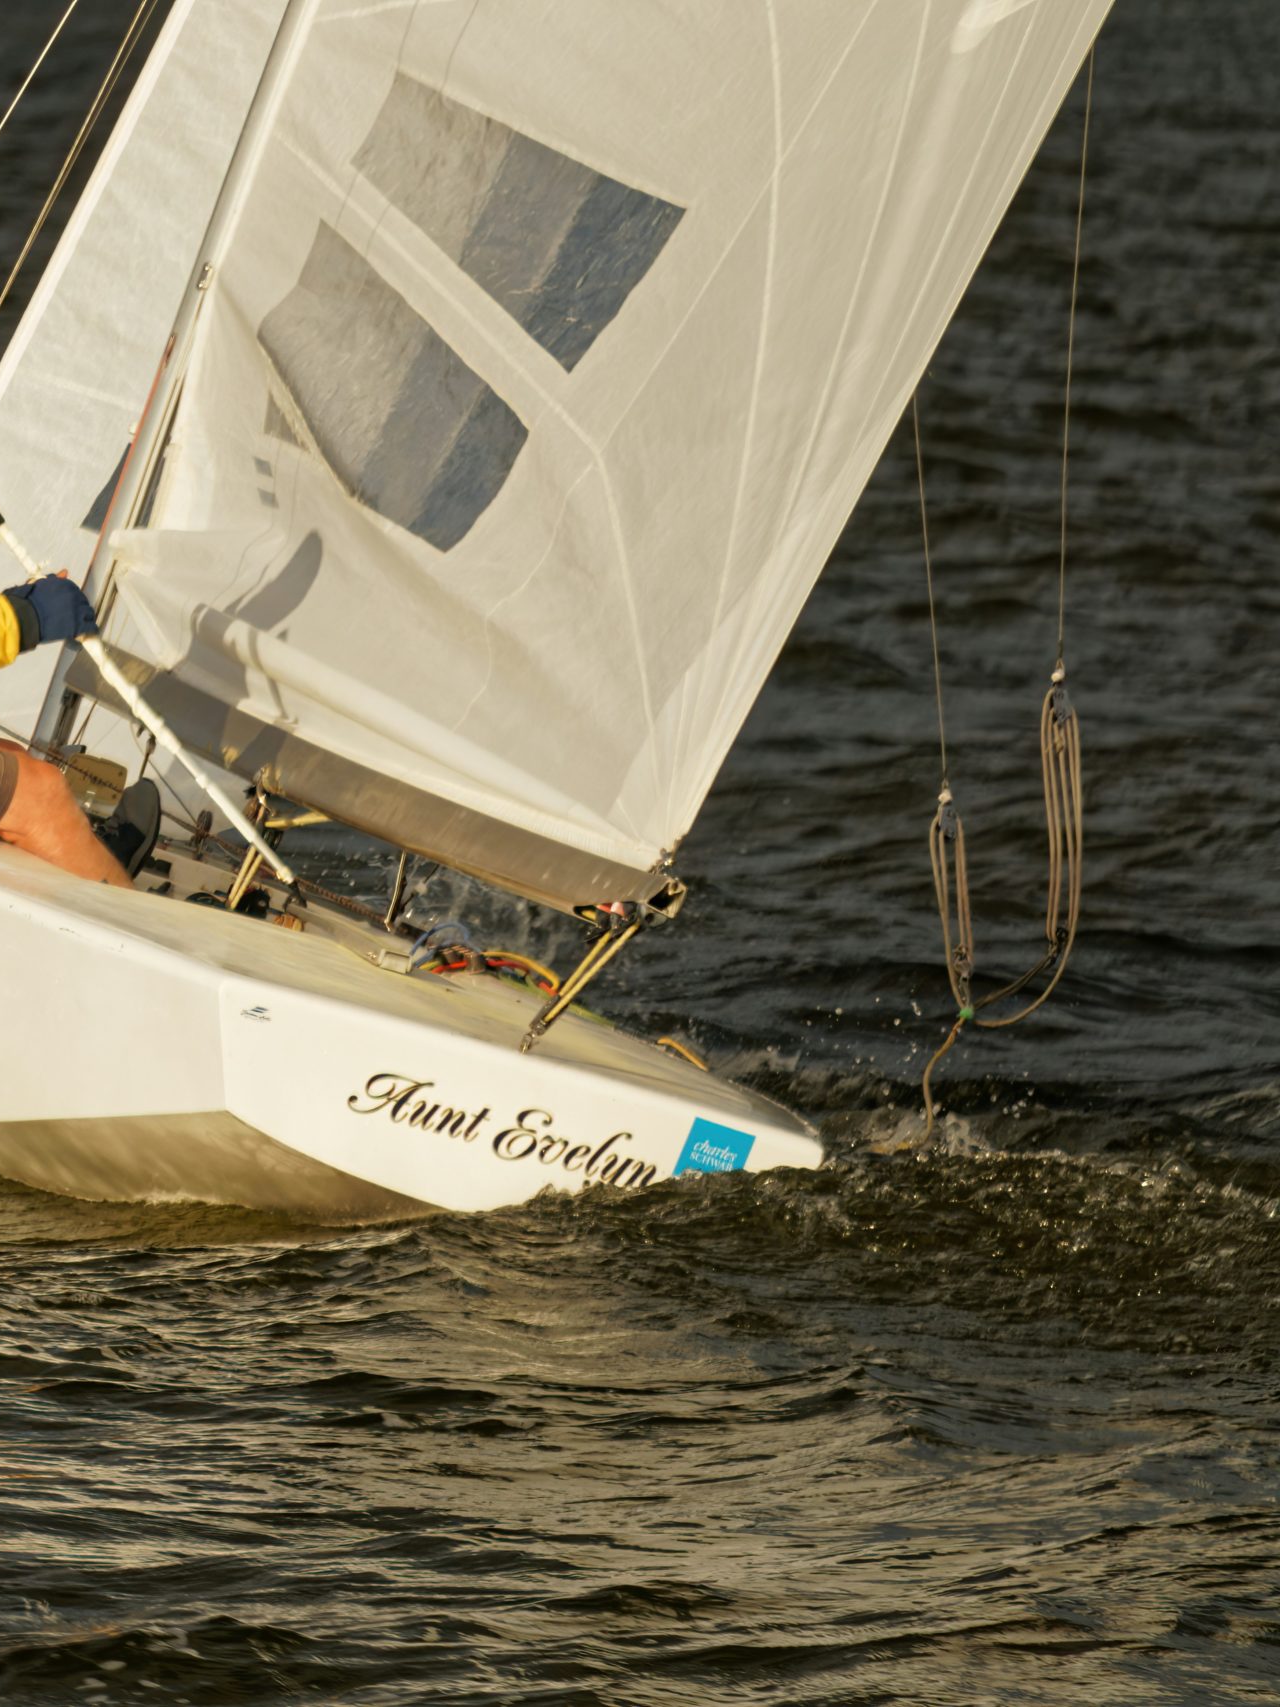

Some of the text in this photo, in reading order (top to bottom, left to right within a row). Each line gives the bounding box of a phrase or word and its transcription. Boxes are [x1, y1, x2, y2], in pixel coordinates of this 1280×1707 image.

[347, 1073, 657, 1187] Aunt Evelyn
[693, 1139, 738, 1162] charles
